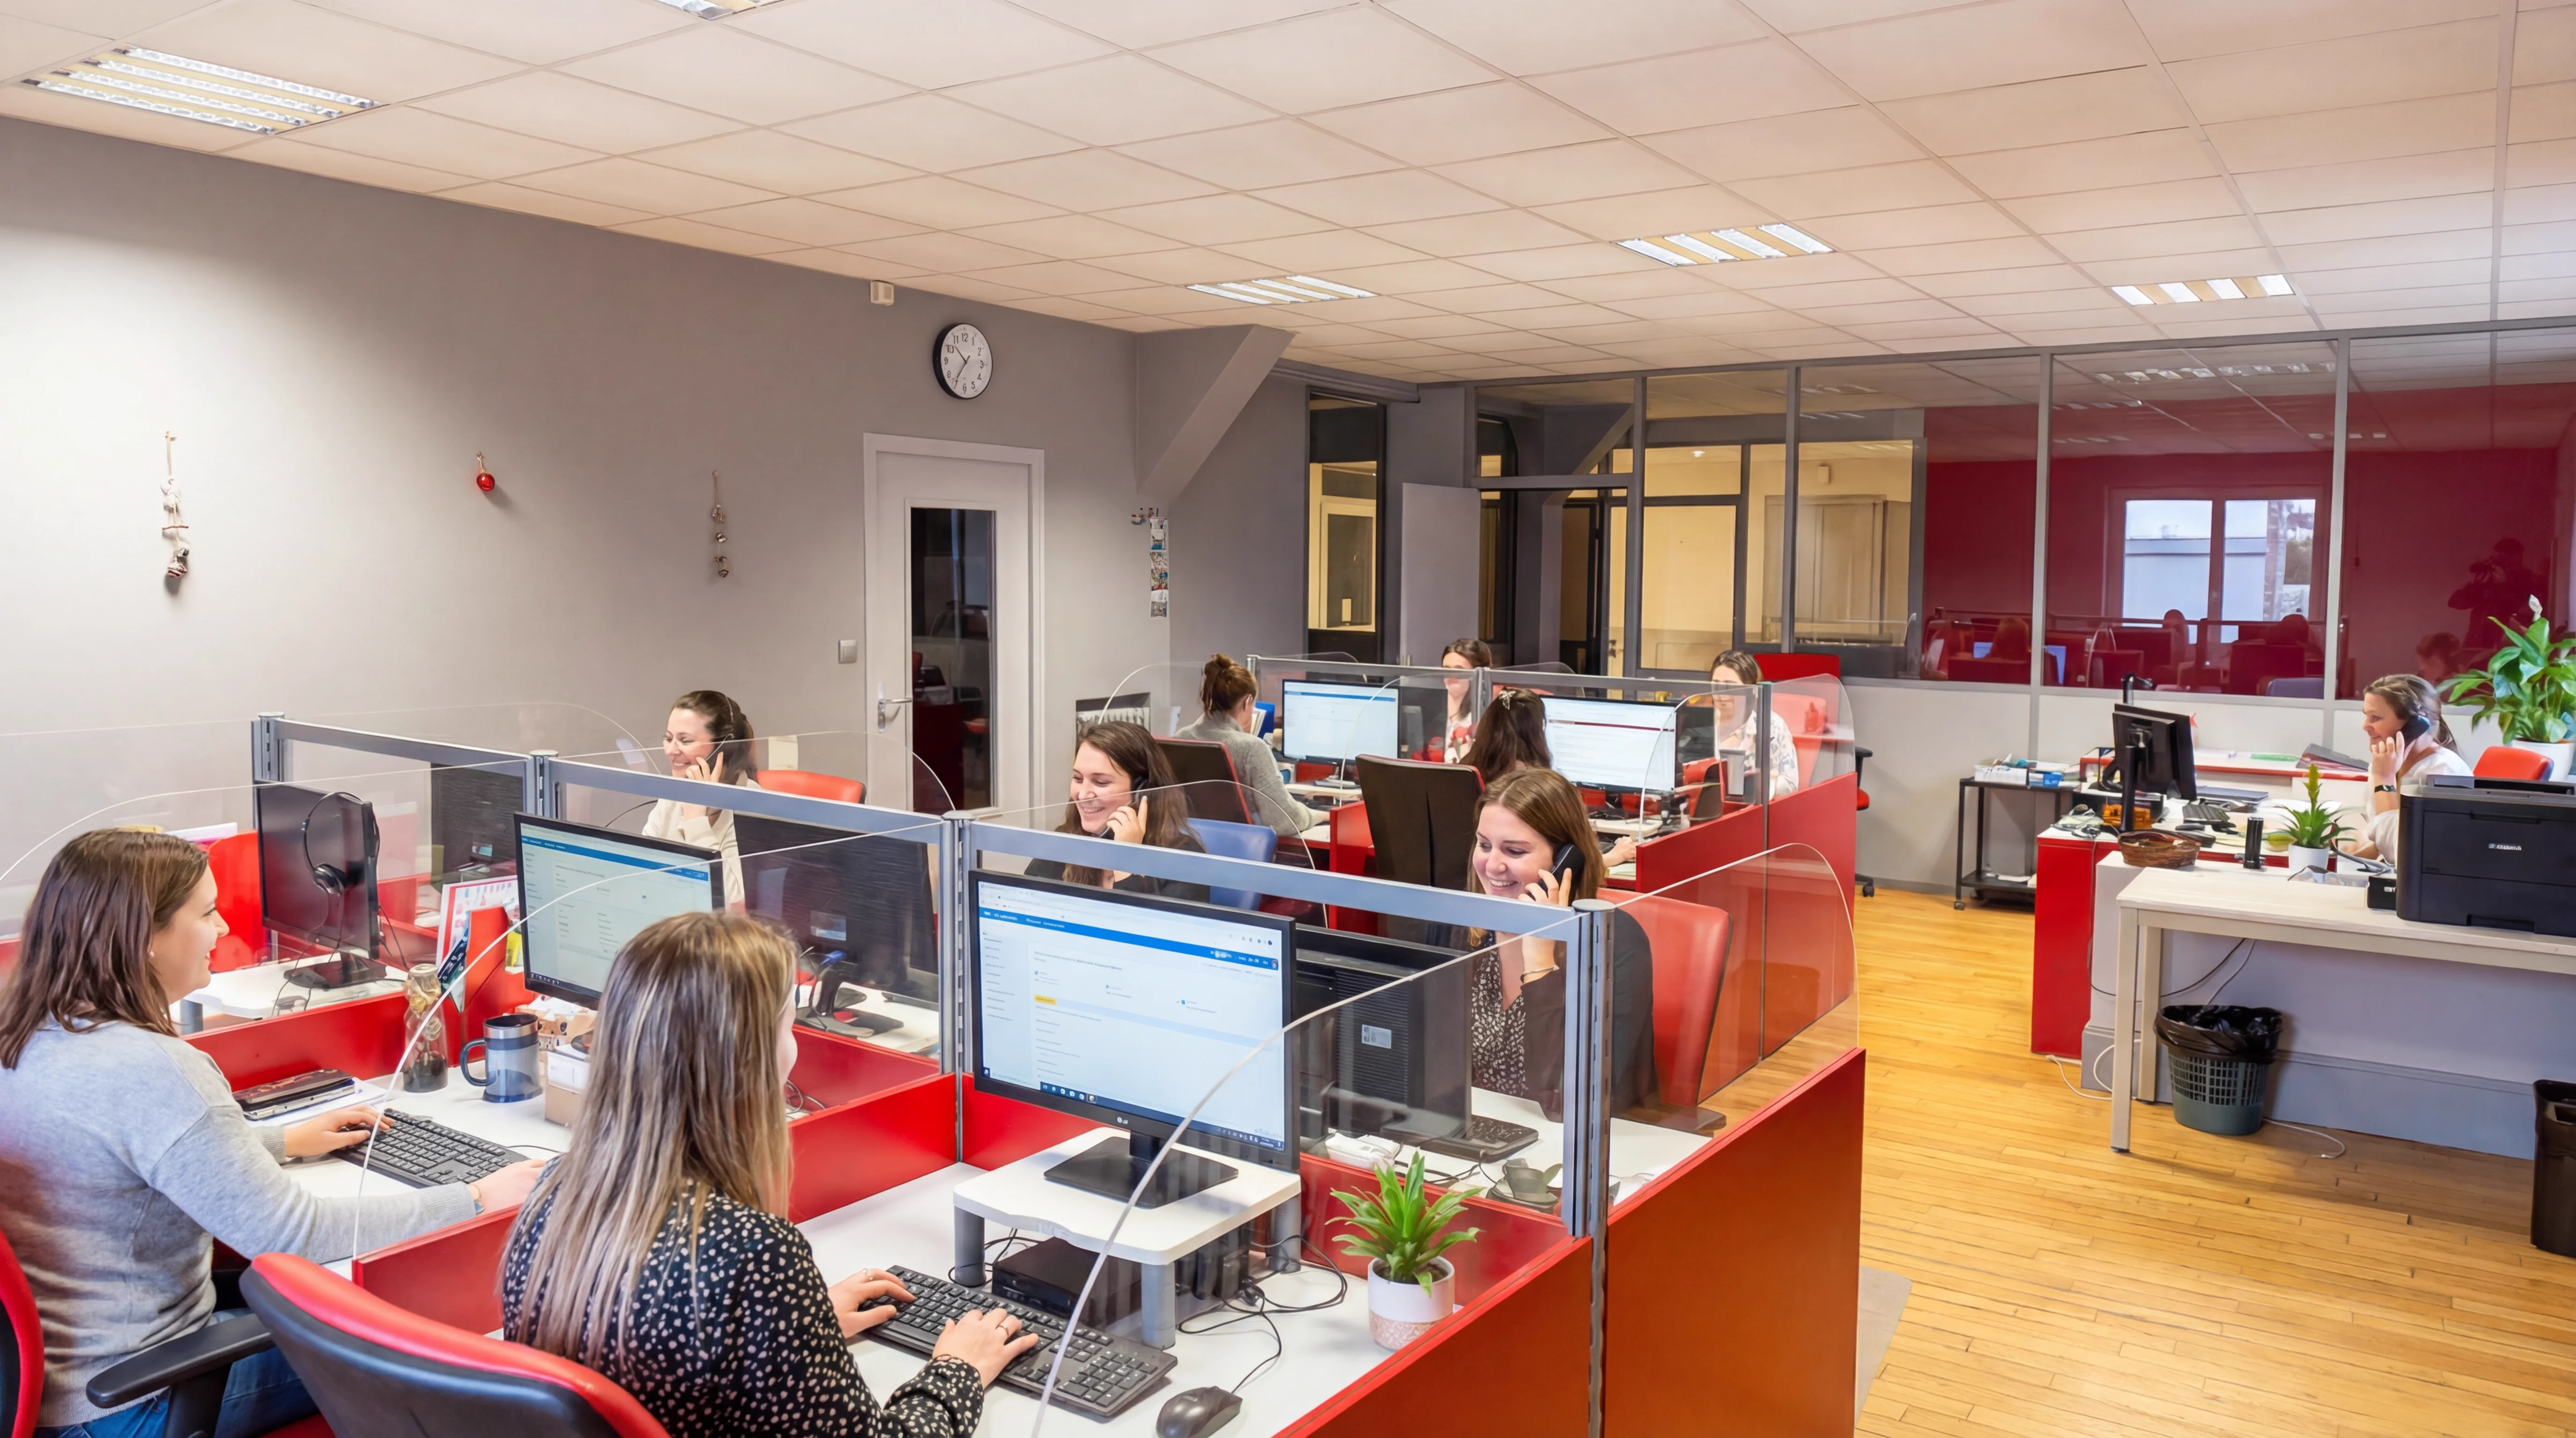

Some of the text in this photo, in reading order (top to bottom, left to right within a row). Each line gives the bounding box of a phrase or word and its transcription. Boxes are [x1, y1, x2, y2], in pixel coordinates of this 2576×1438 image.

[953, 335, 959, 344] 11
[961, 333, 968, 342] 12
[977, 347, 982, 356] 2
[980, 360, 984, 369] 3
[971, 381, 975, 389] 5
